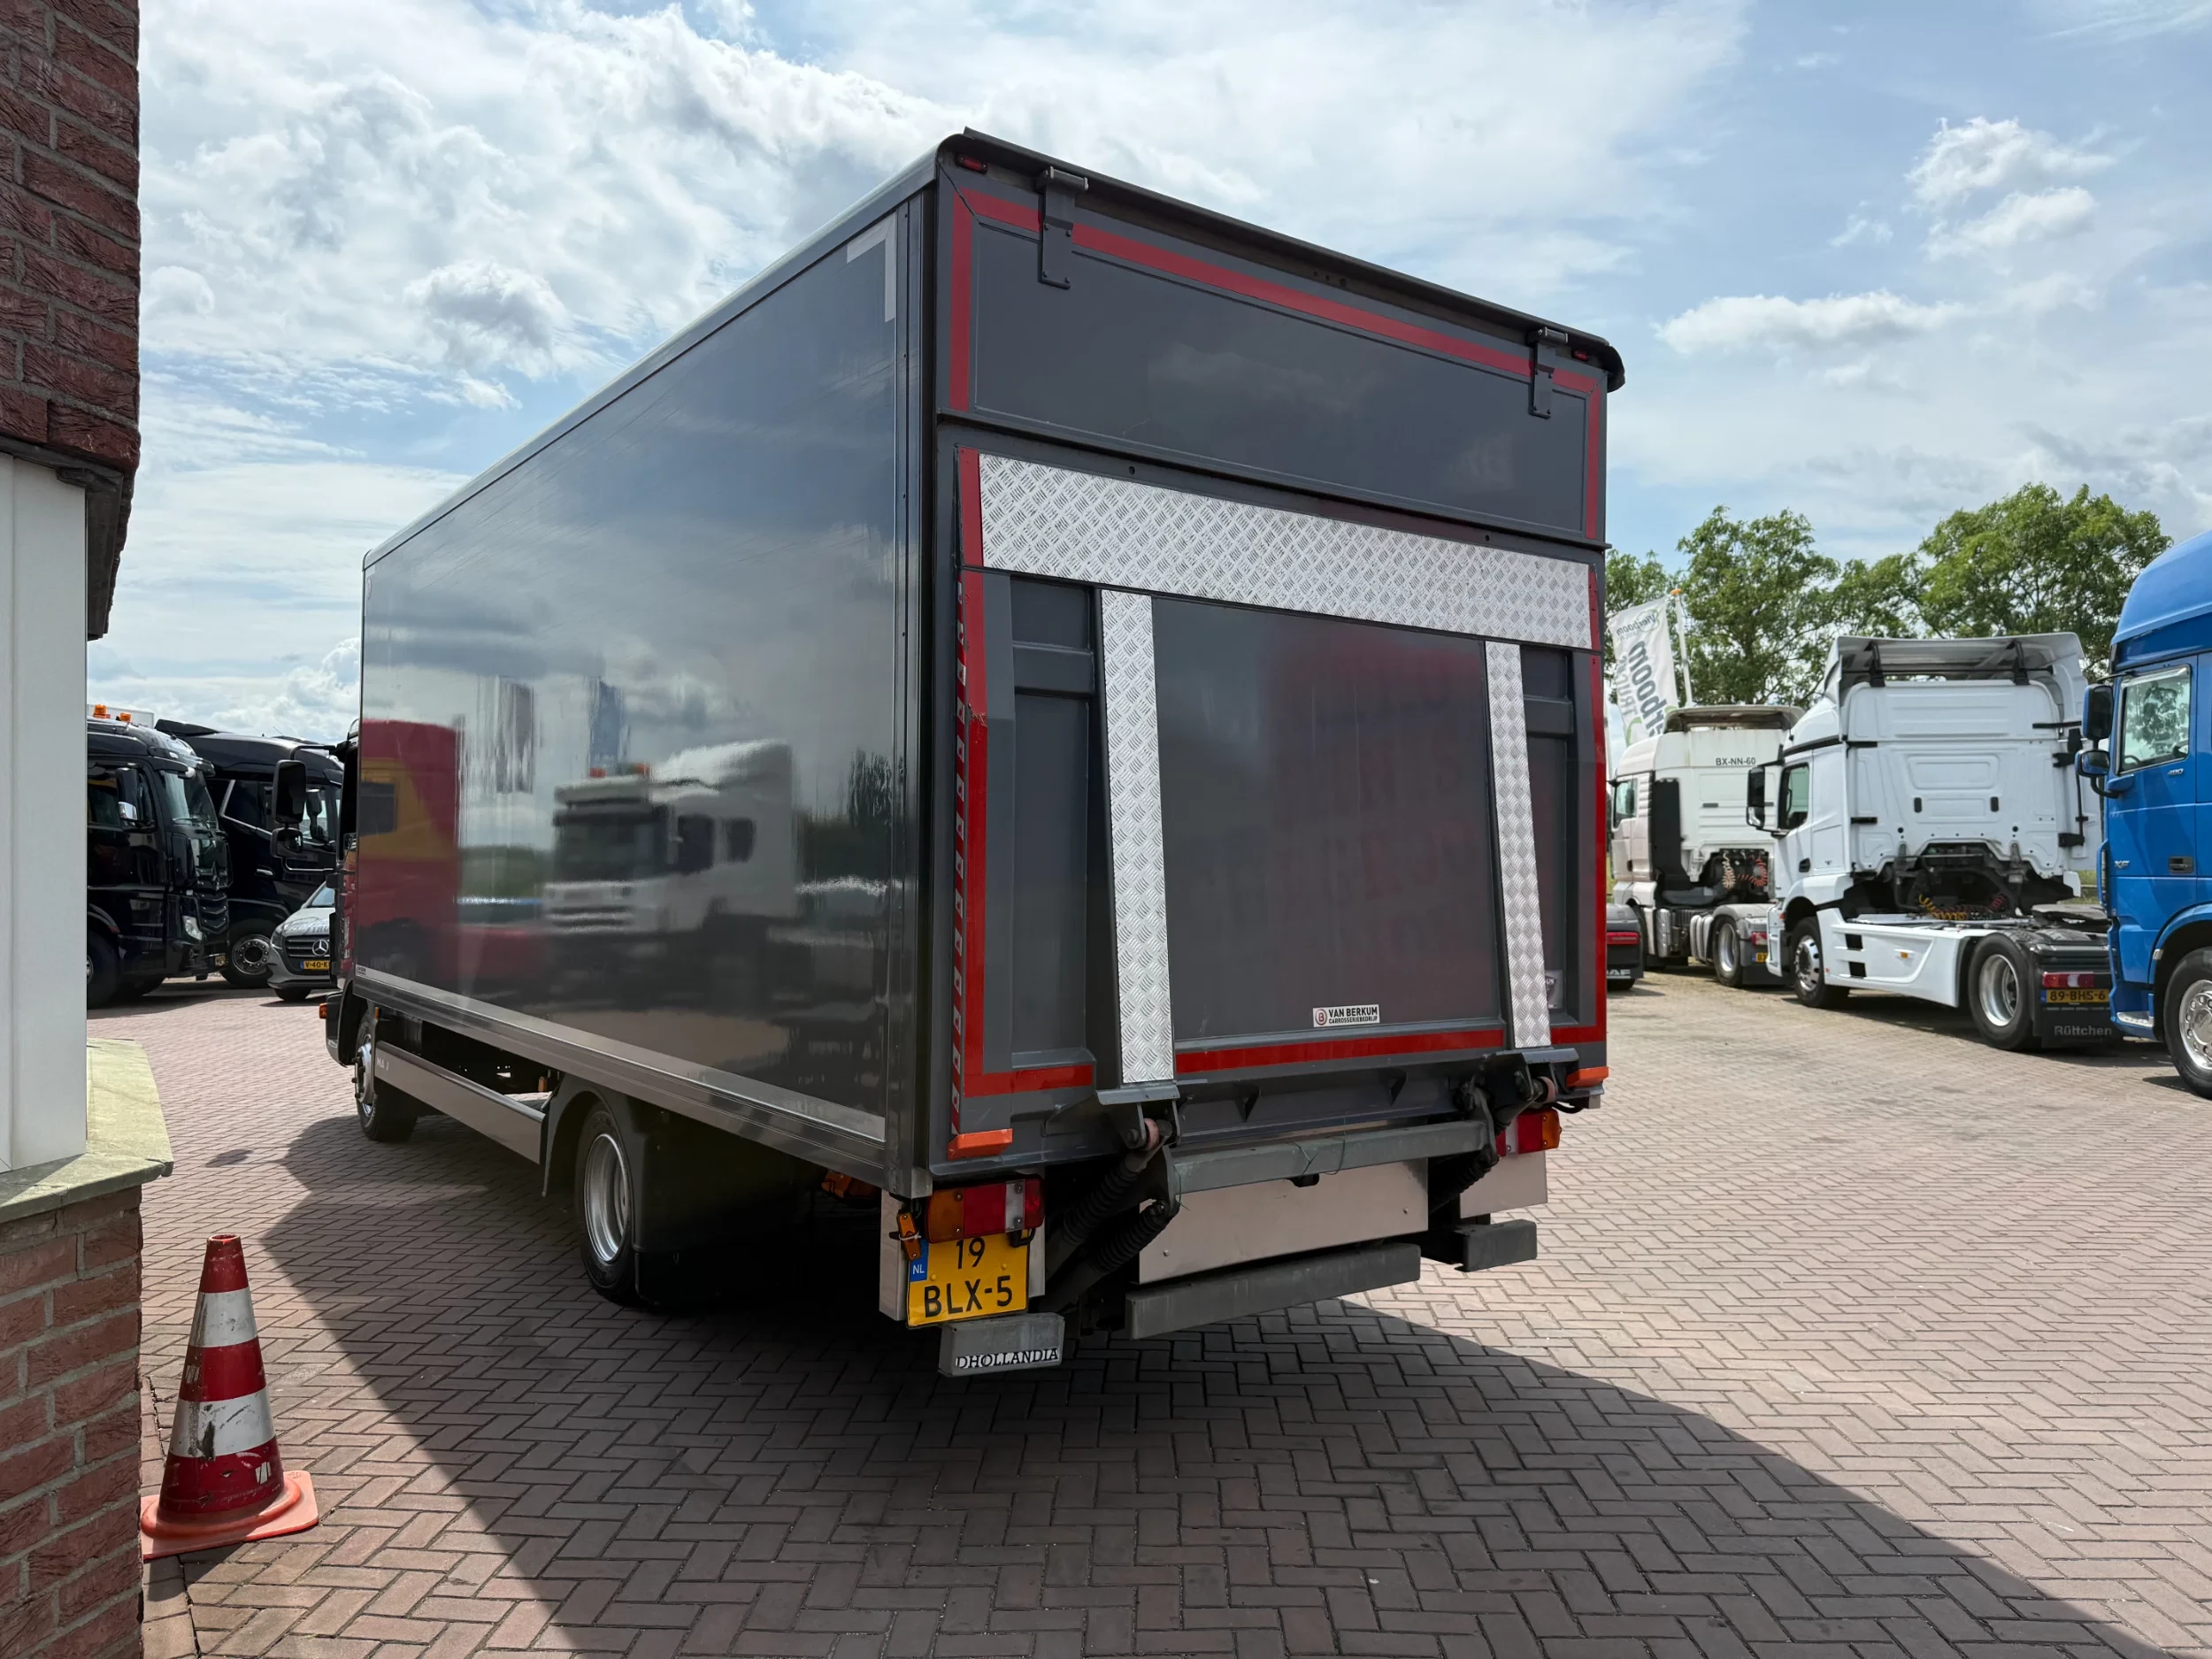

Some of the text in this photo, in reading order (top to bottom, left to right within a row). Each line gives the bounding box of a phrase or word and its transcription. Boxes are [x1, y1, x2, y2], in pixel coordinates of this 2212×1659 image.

[1715, 757, 1756, 765] BX-NN-60
[2049, 990, 2106, 1001] 89-BHS-6
[1328, 1006, 1378, 1018] VAN BERKUM
[1328, 1015, 1378, 1024] CARROSSERIEBEDRIJF
[2054, 1025, 2112, 1036] Rüttchen
[956, 1237, 986, 1270] 19
[912, 1264, 926, 1275] NL
[924, 1275, 1013, 1318] BLX-5
[956, 1348, 1059, 1369] DHOLLANDIA
